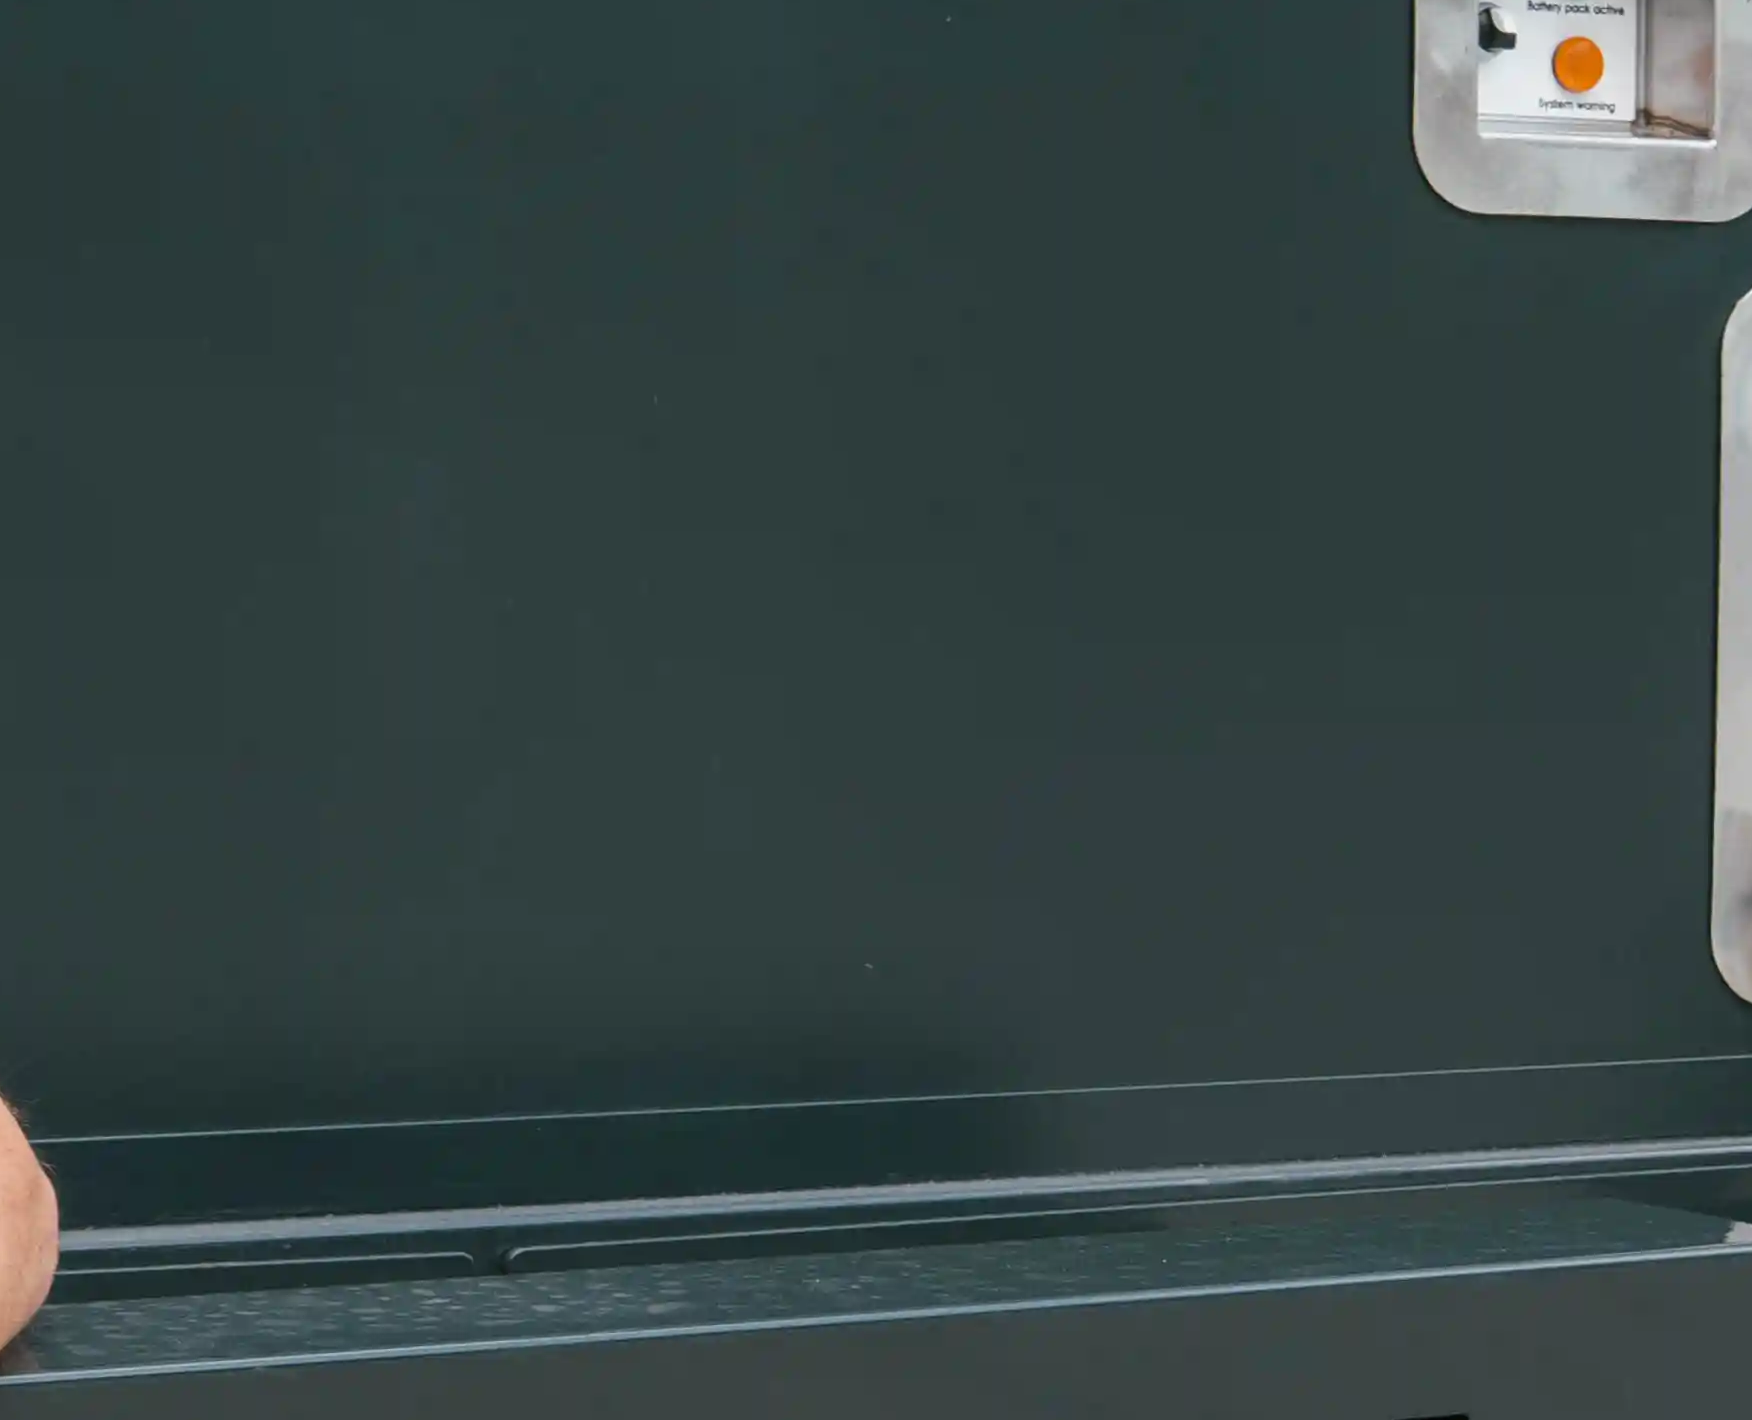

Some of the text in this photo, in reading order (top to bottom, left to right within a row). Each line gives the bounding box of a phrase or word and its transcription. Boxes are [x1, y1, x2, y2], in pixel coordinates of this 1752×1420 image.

[1527, 0, 1625, 16] Battery pack active
[1538, 96, 1615, 114] System warning
